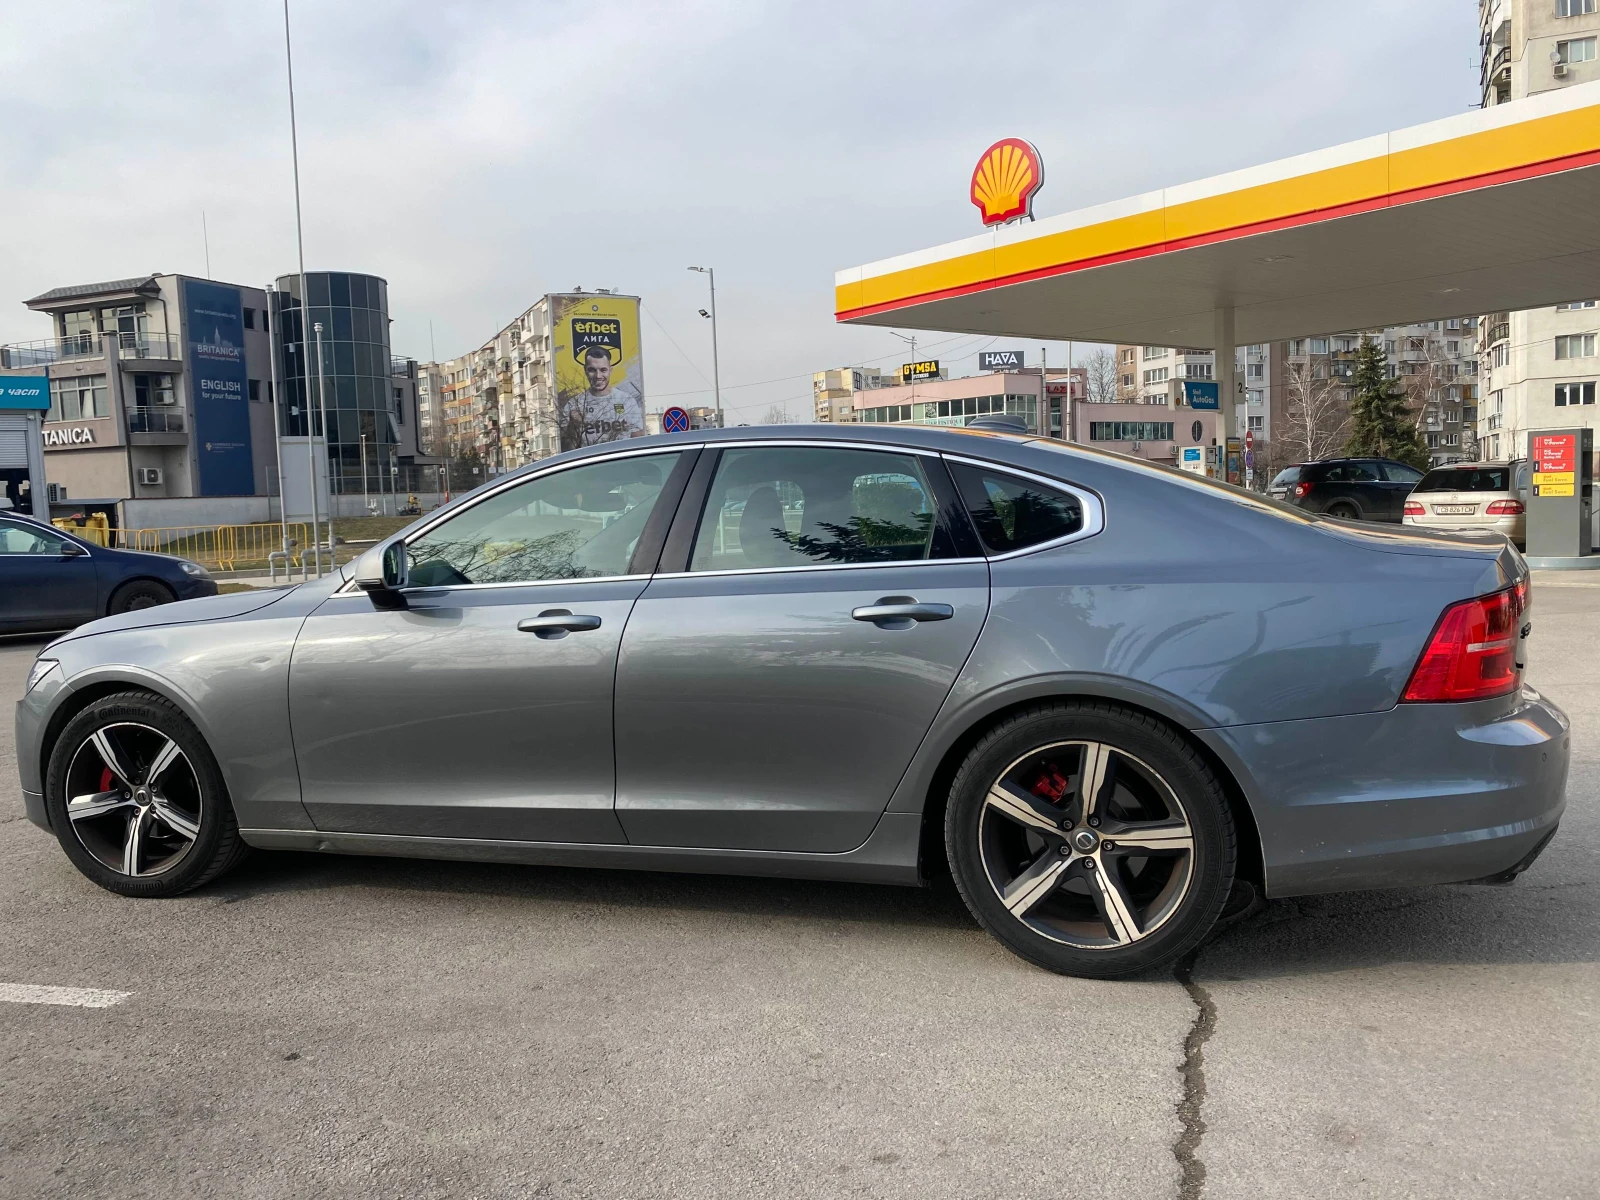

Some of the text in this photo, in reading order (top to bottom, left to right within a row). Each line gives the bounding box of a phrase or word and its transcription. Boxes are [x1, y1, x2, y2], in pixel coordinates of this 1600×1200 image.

[574, 321, 618, 334] efbet
[583, 335, 610, 343] ЛИГА
[197, 344, 239, 357] BRITANICA
[985, 353, 1018, 365] HAVA
[903, 361, 937, 375] GYMSA
[201, 379, 241, 391] ENGLISH
[1045, 385, 1076, 394] LAZA
[1238, 382, 1243, 393] 2
[8, 387, 40, 396] част
[1192, 395, 1215, 404] AutoGas
[98, 704, 150, 720] Continental
[114, 880, 164, 891] Continental
